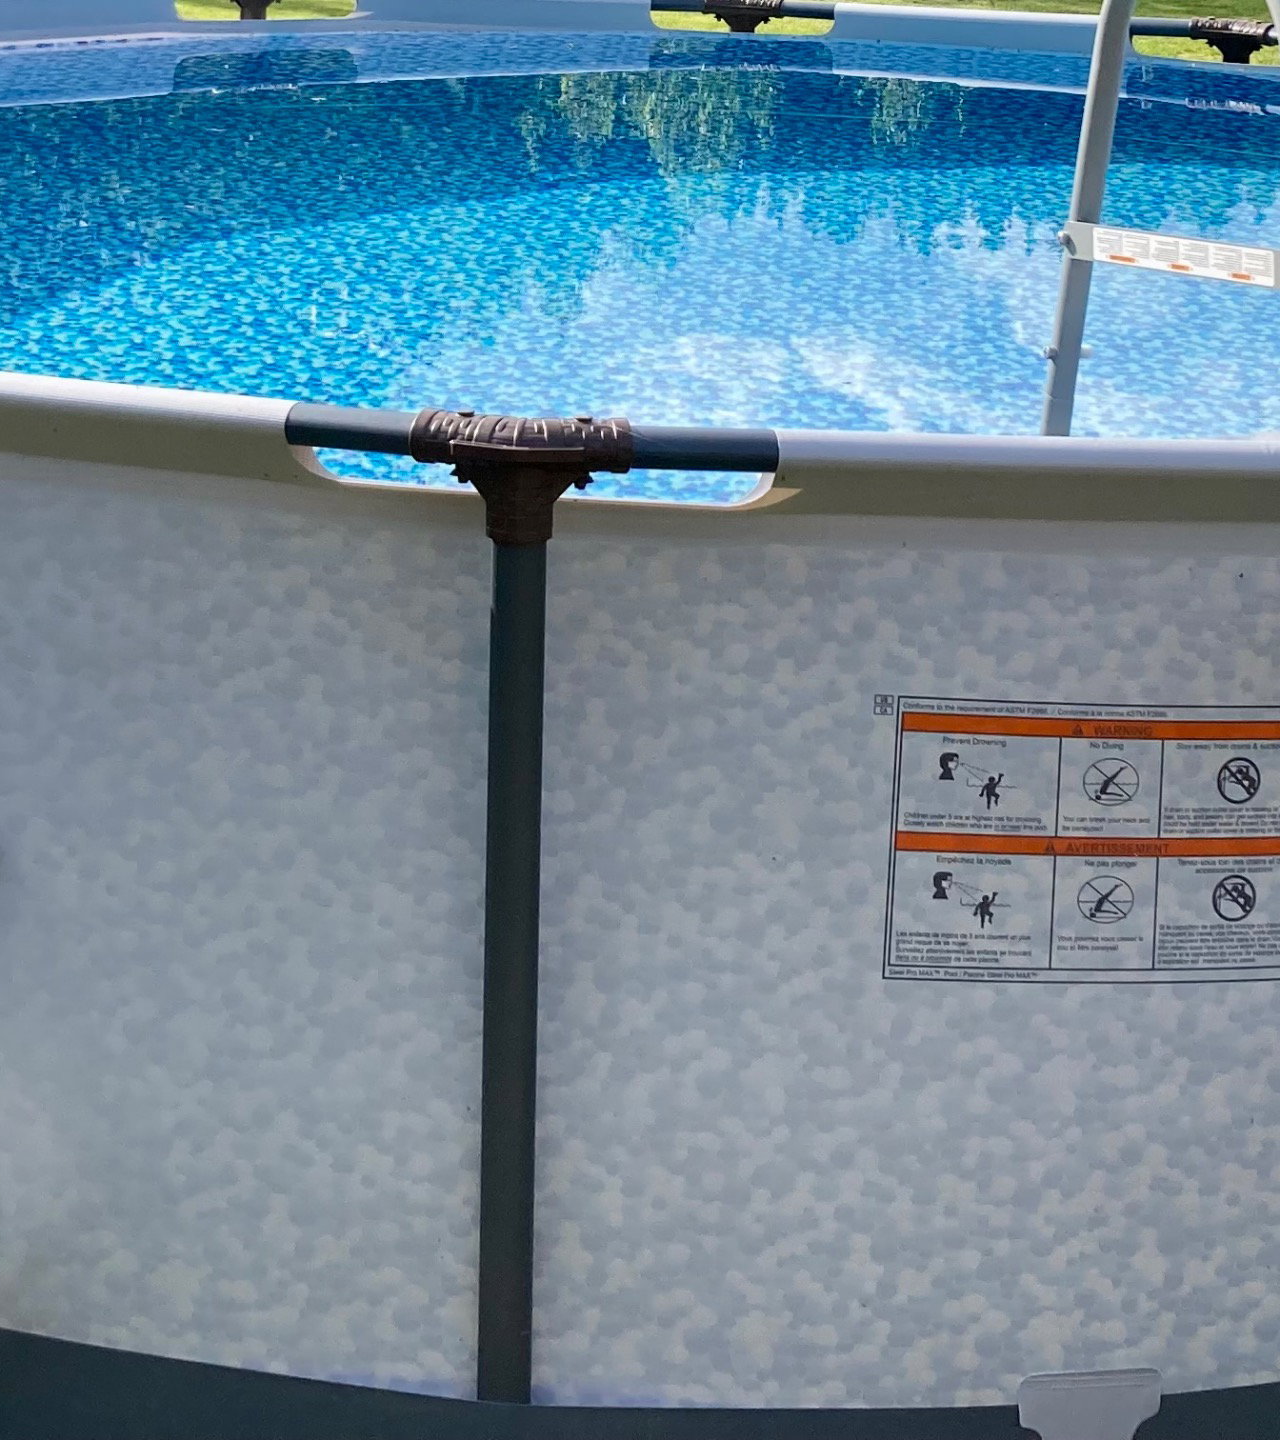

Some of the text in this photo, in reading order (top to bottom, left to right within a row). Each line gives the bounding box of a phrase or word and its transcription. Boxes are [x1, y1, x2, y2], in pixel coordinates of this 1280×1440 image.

[1094, 725, 1152, 736] WARNING
[972, 737, 1007, 748] Drowning
[1066, 842, 1169, 854] AVERTISSEMENT
